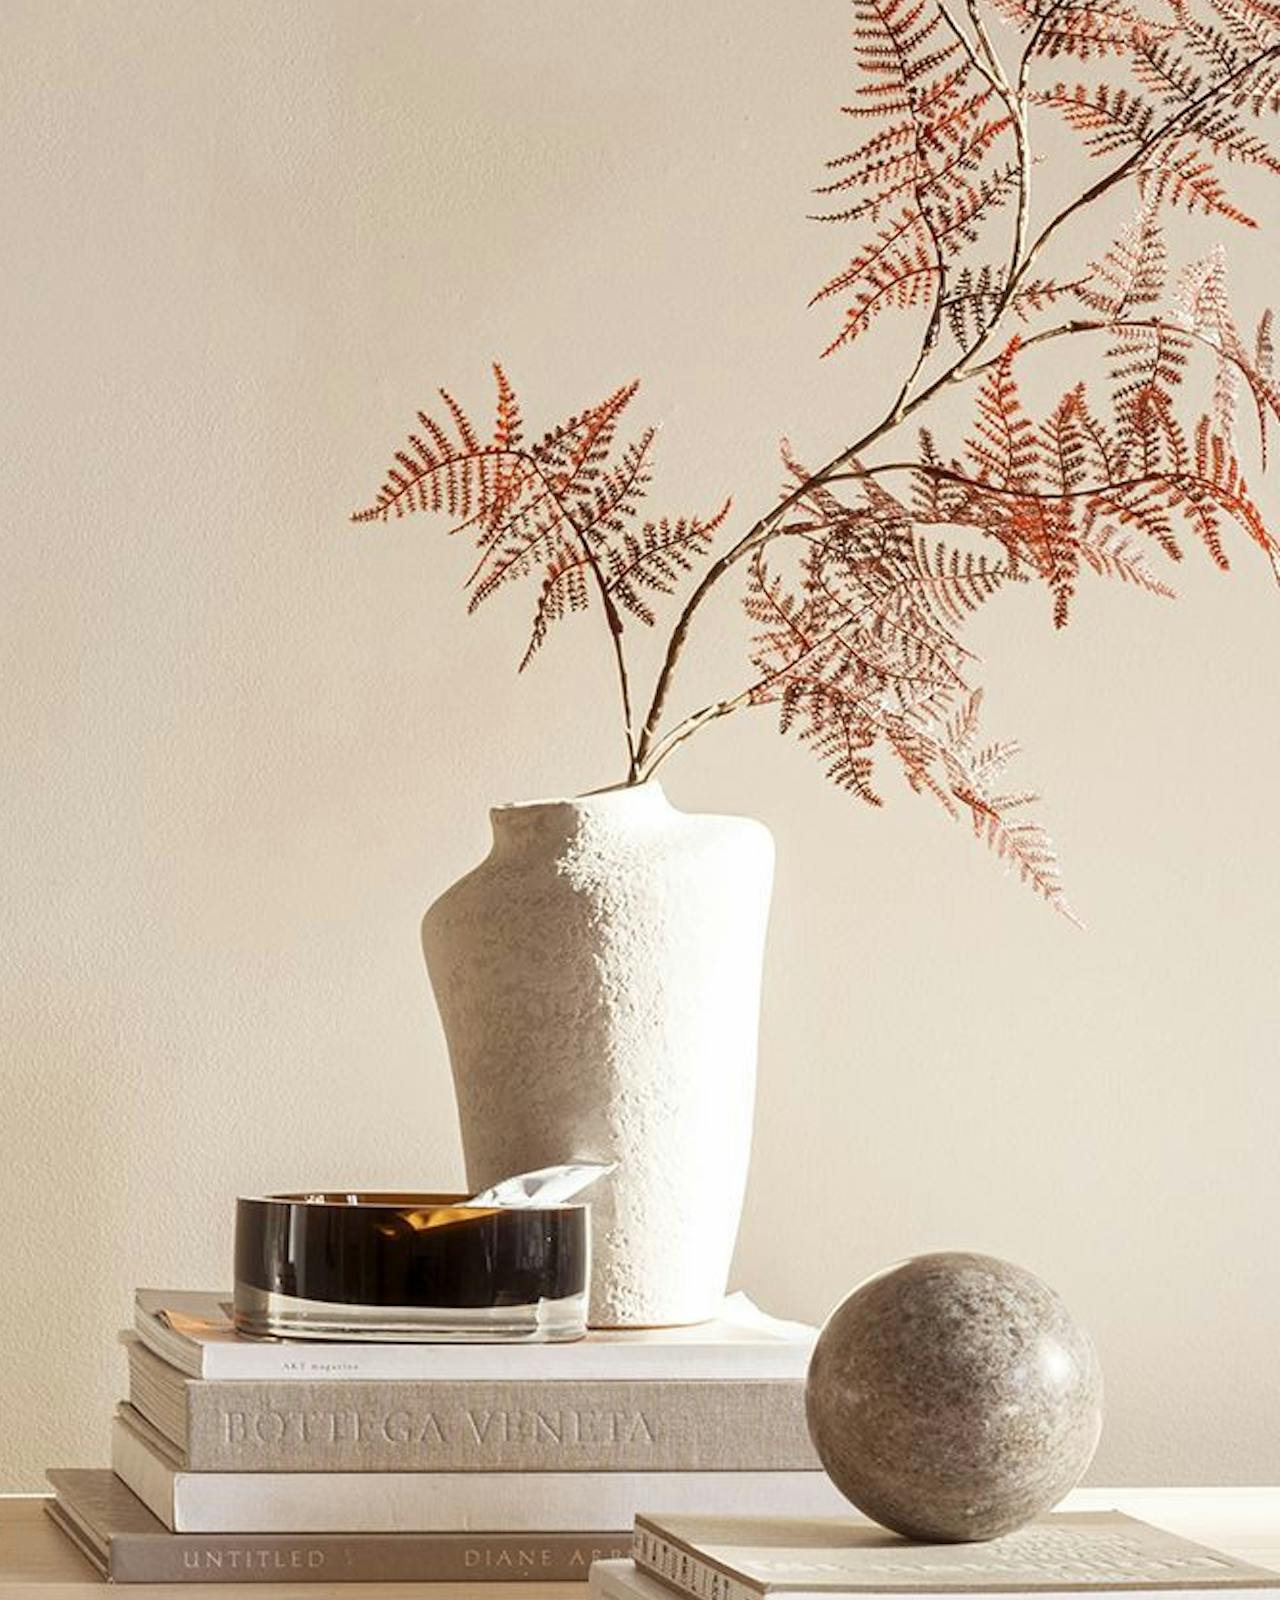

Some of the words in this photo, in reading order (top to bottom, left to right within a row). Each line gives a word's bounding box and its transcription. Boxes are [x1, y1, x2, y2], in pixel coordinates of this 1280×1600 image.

[223, 1409, 448, 1445] BOTTEGA
[466, 1409, 657, 1446] VENETA
[183, 1549, 326, 1569] UNTITLED
[464, 1548, 552, 1568] DIANE
